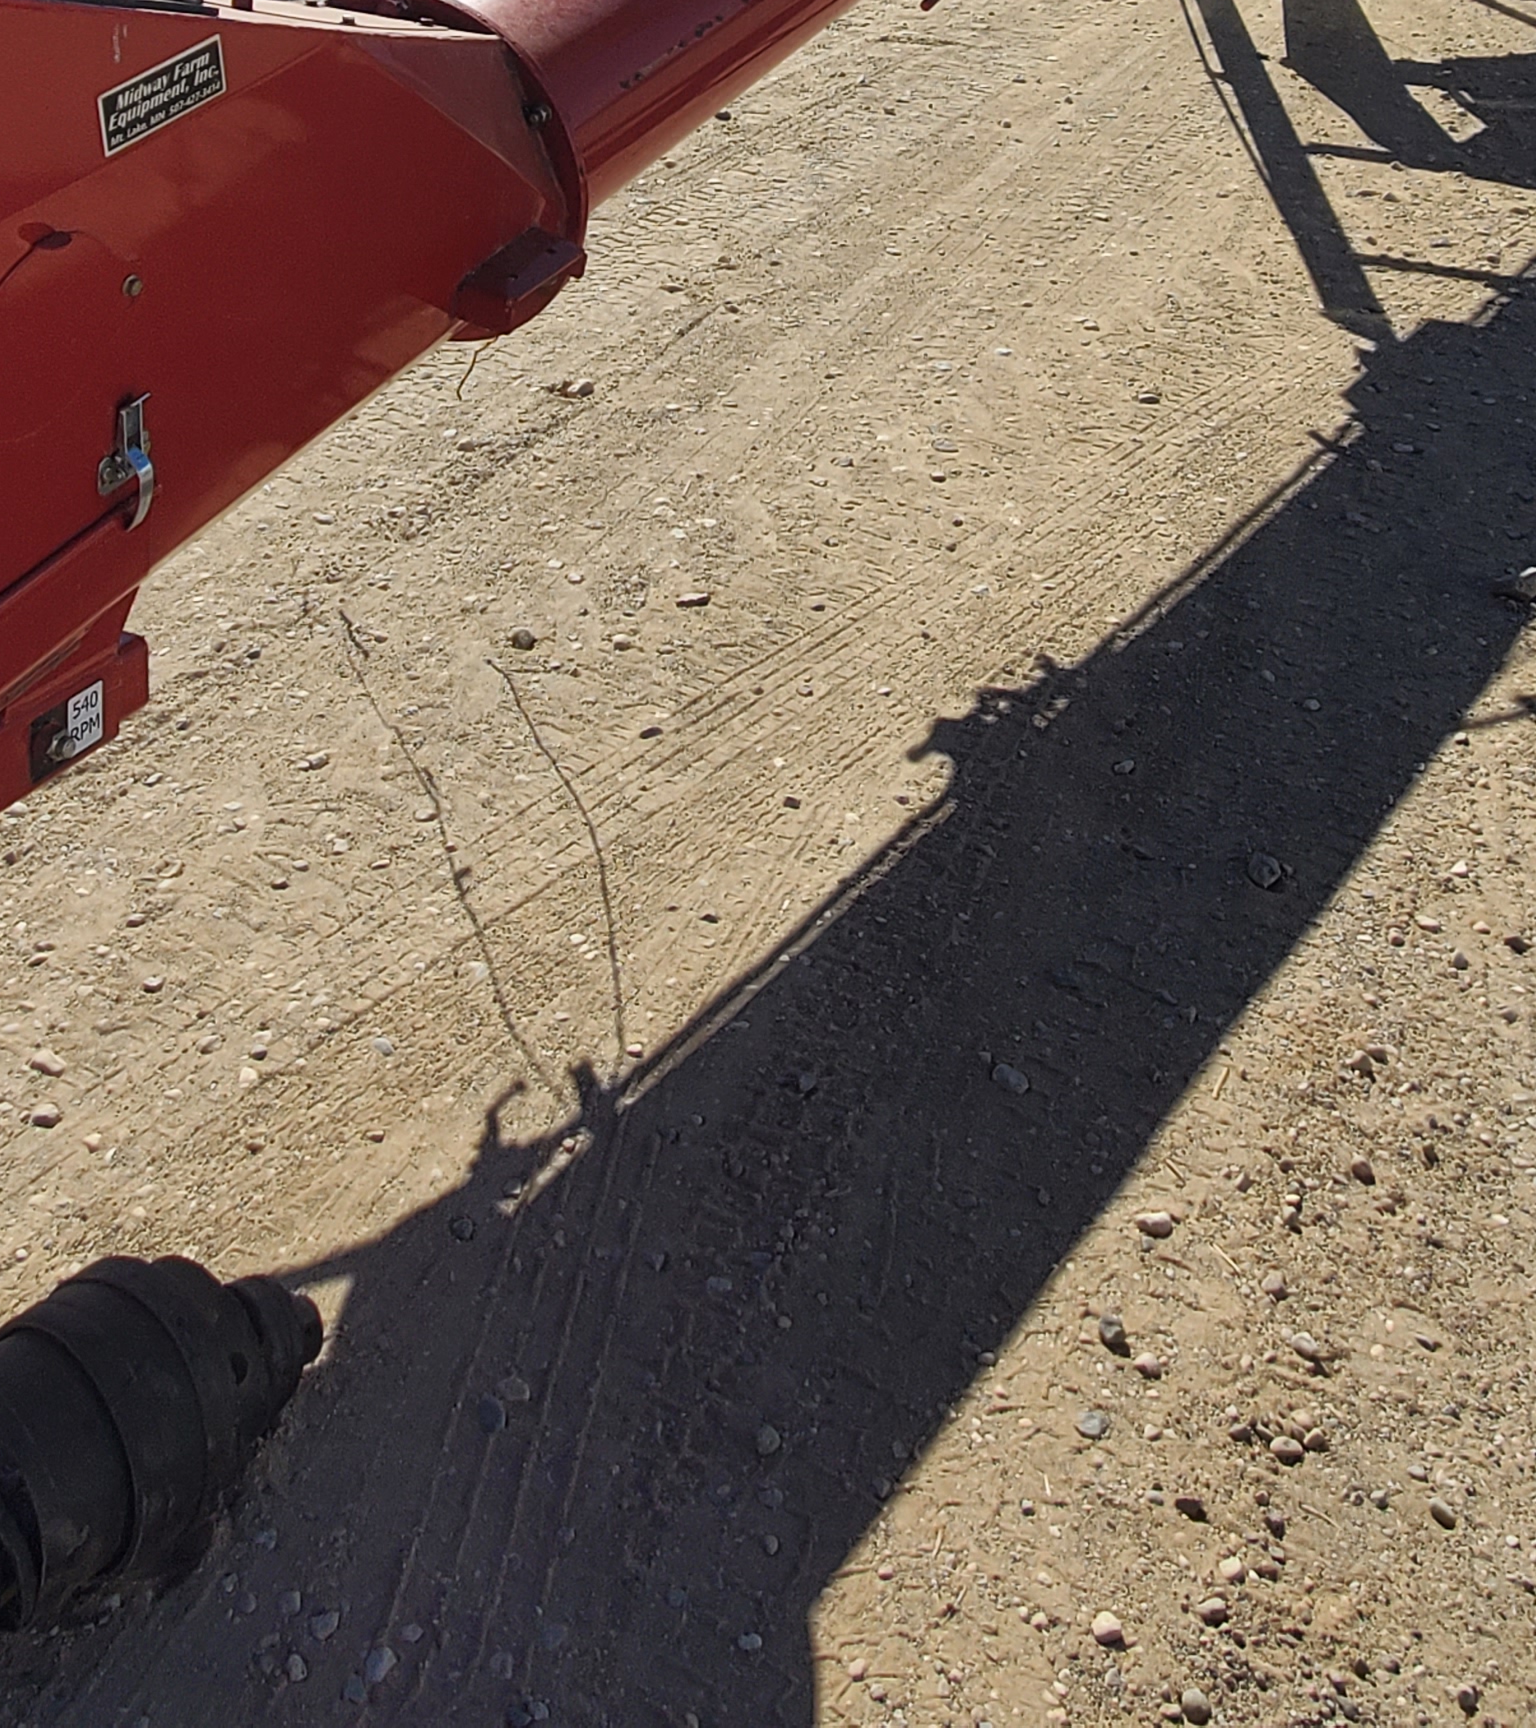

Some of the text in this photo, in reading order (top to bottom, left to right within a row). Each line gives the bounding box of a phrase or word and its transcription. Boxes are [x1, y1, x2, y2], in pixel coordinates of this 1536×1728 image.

[115, 52, 210, 111] Midway Farm
[108, 65, 220, 131] Equipment, Inc.
[150, 110, 166, 125] MN
[72, 690, 99, 720] 540
[70, 712, 100, 741] RPM
